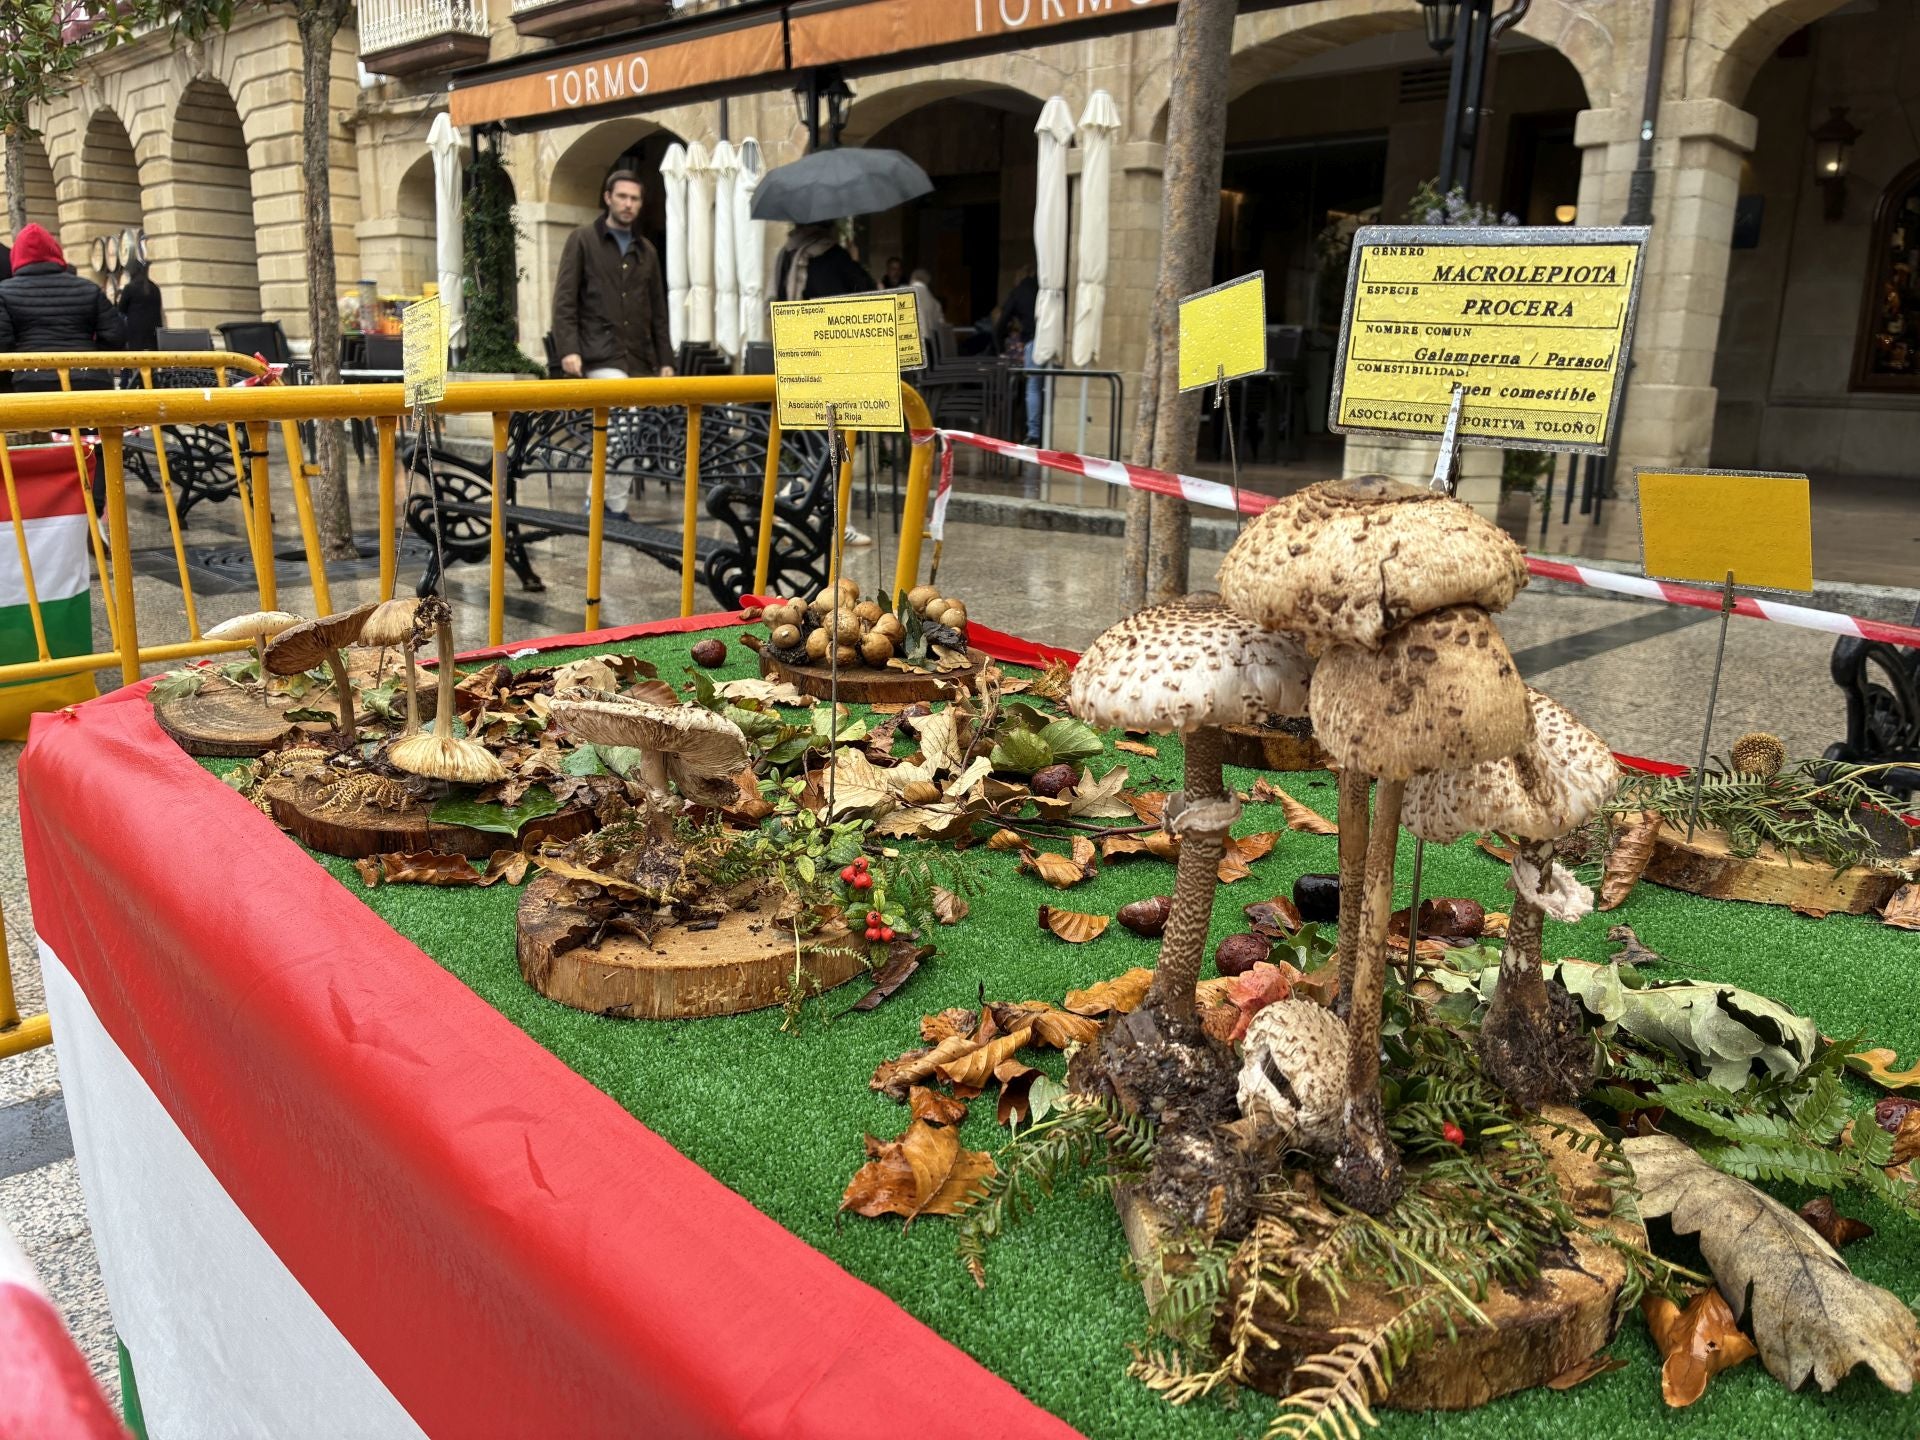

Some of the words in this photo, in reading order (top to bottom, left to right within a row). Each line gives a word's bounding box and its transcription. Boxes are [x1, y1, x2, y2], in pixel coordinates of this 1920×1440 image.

[546, 56, 649, 108] TORMO
[1432, 265, 1616, 283] MACROLEPIOTA
[1367, 286, 1419, 295] ESPECIE
[1461, 299, 1573, 317] PROCERA
[828, 313, 894, 325] MACROLEPIOTA
[814, 327, 894, 340] PSEUDOLIVASCENS
[1365, 325, 1419, 335] NOMBRE
[1425, 326, 1472, 337] COMUN
[1414, 347, 1521, 366] Galamperna
[1544, 352, 1613, 368] Parasol
[1357, 363, 1469, 377] COMESTIBILIDAD:
[1500, 386, 1597, 402] comestible
[788, 400, 824, 409] Asociación
[816, 413, 829, 421] Har
[835, 413, 843, 421] La
[844, 413, 862, 423] Rioja
[1348, 409, 1434, 423] ASOCIACION
[1442, 415, 1526, 430] DPORTIVA
[1534, 420, 1597, 435] TOLOÑO
